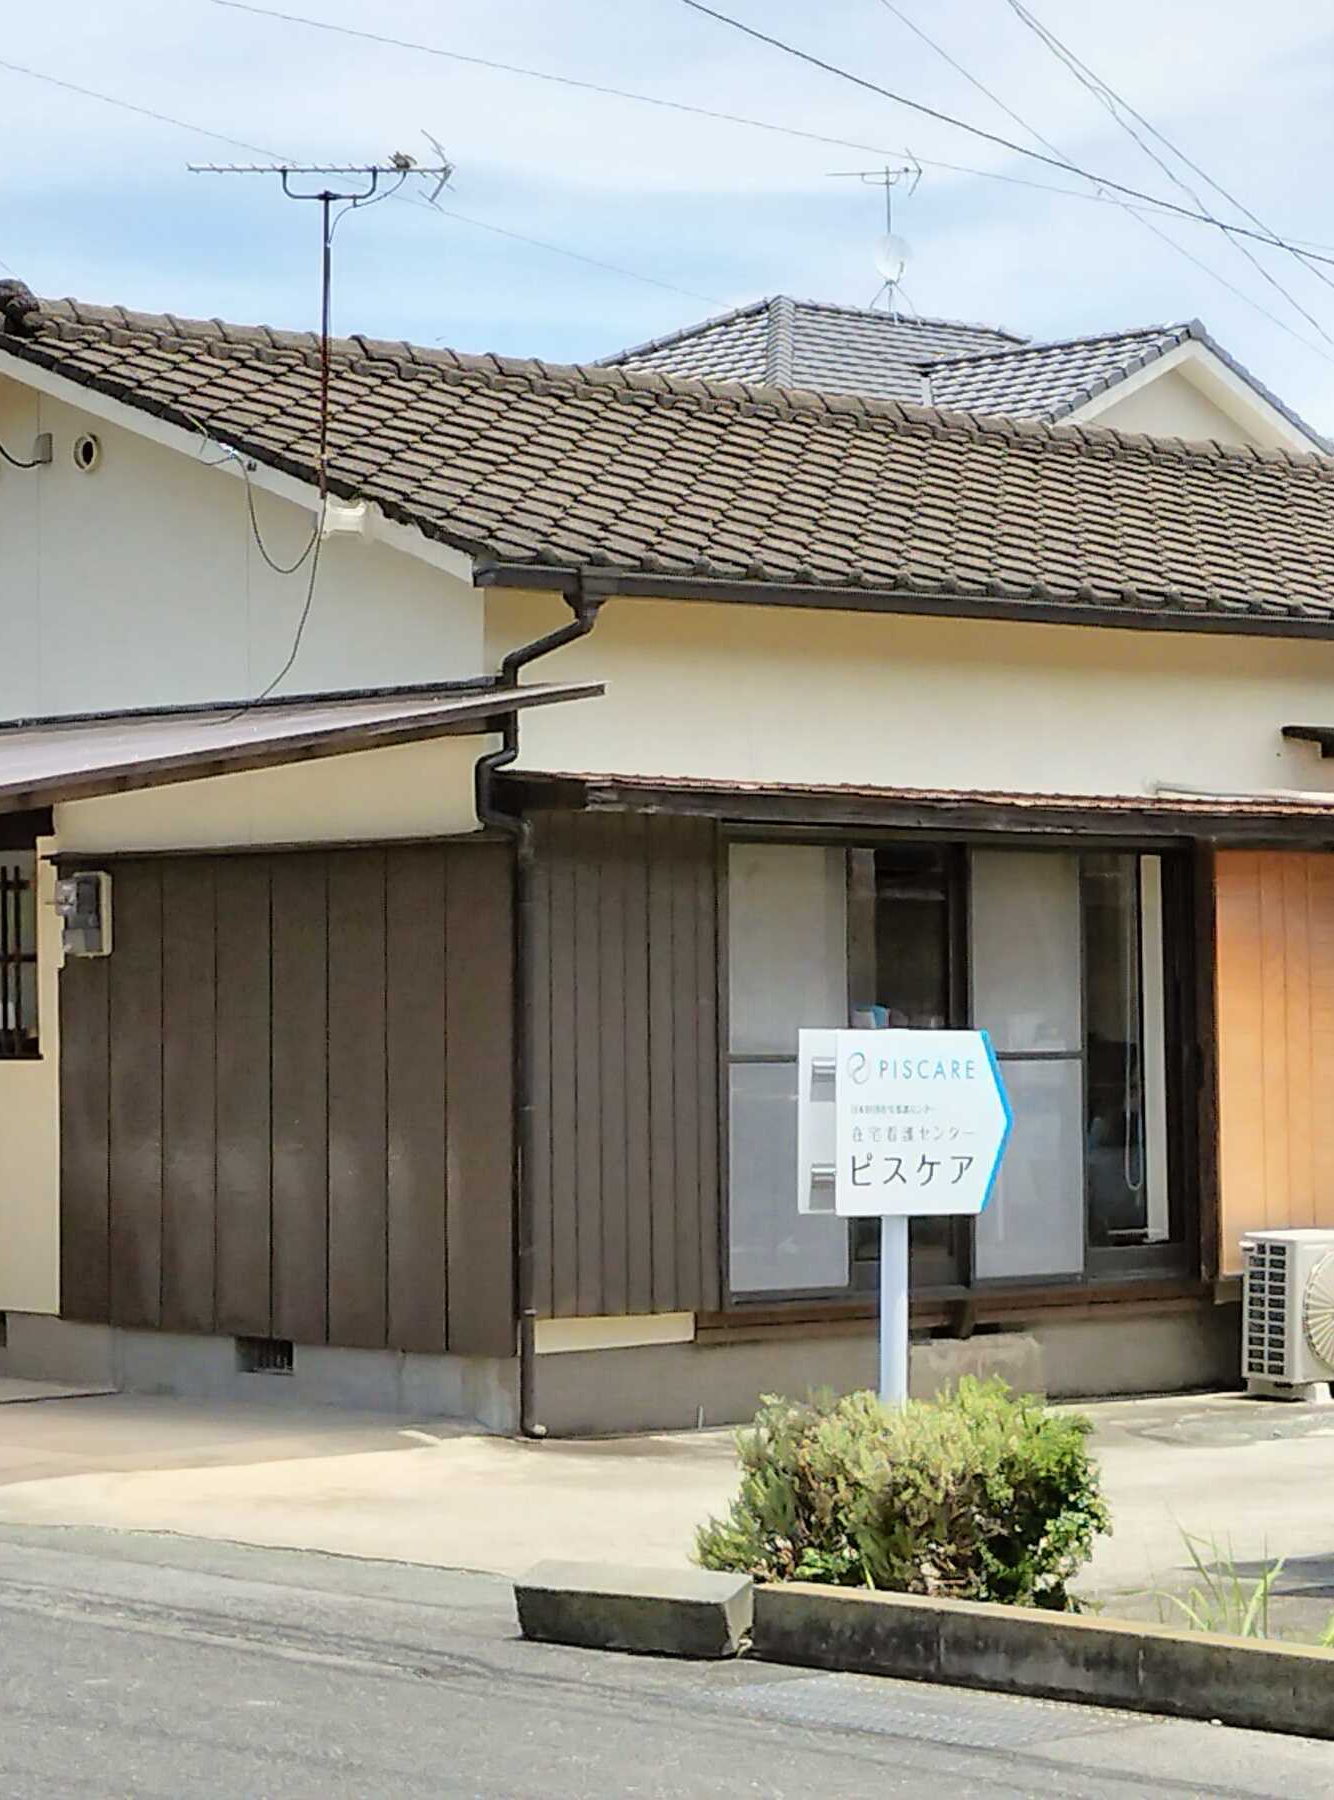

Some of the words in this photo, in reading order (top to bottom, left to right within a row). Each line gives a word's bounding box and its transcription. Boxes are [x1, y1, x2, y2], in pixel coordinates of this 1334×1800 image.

[878, 1059, 975, 1079] PISCARE
[851, 1153, 973, 1186] ピスケア
